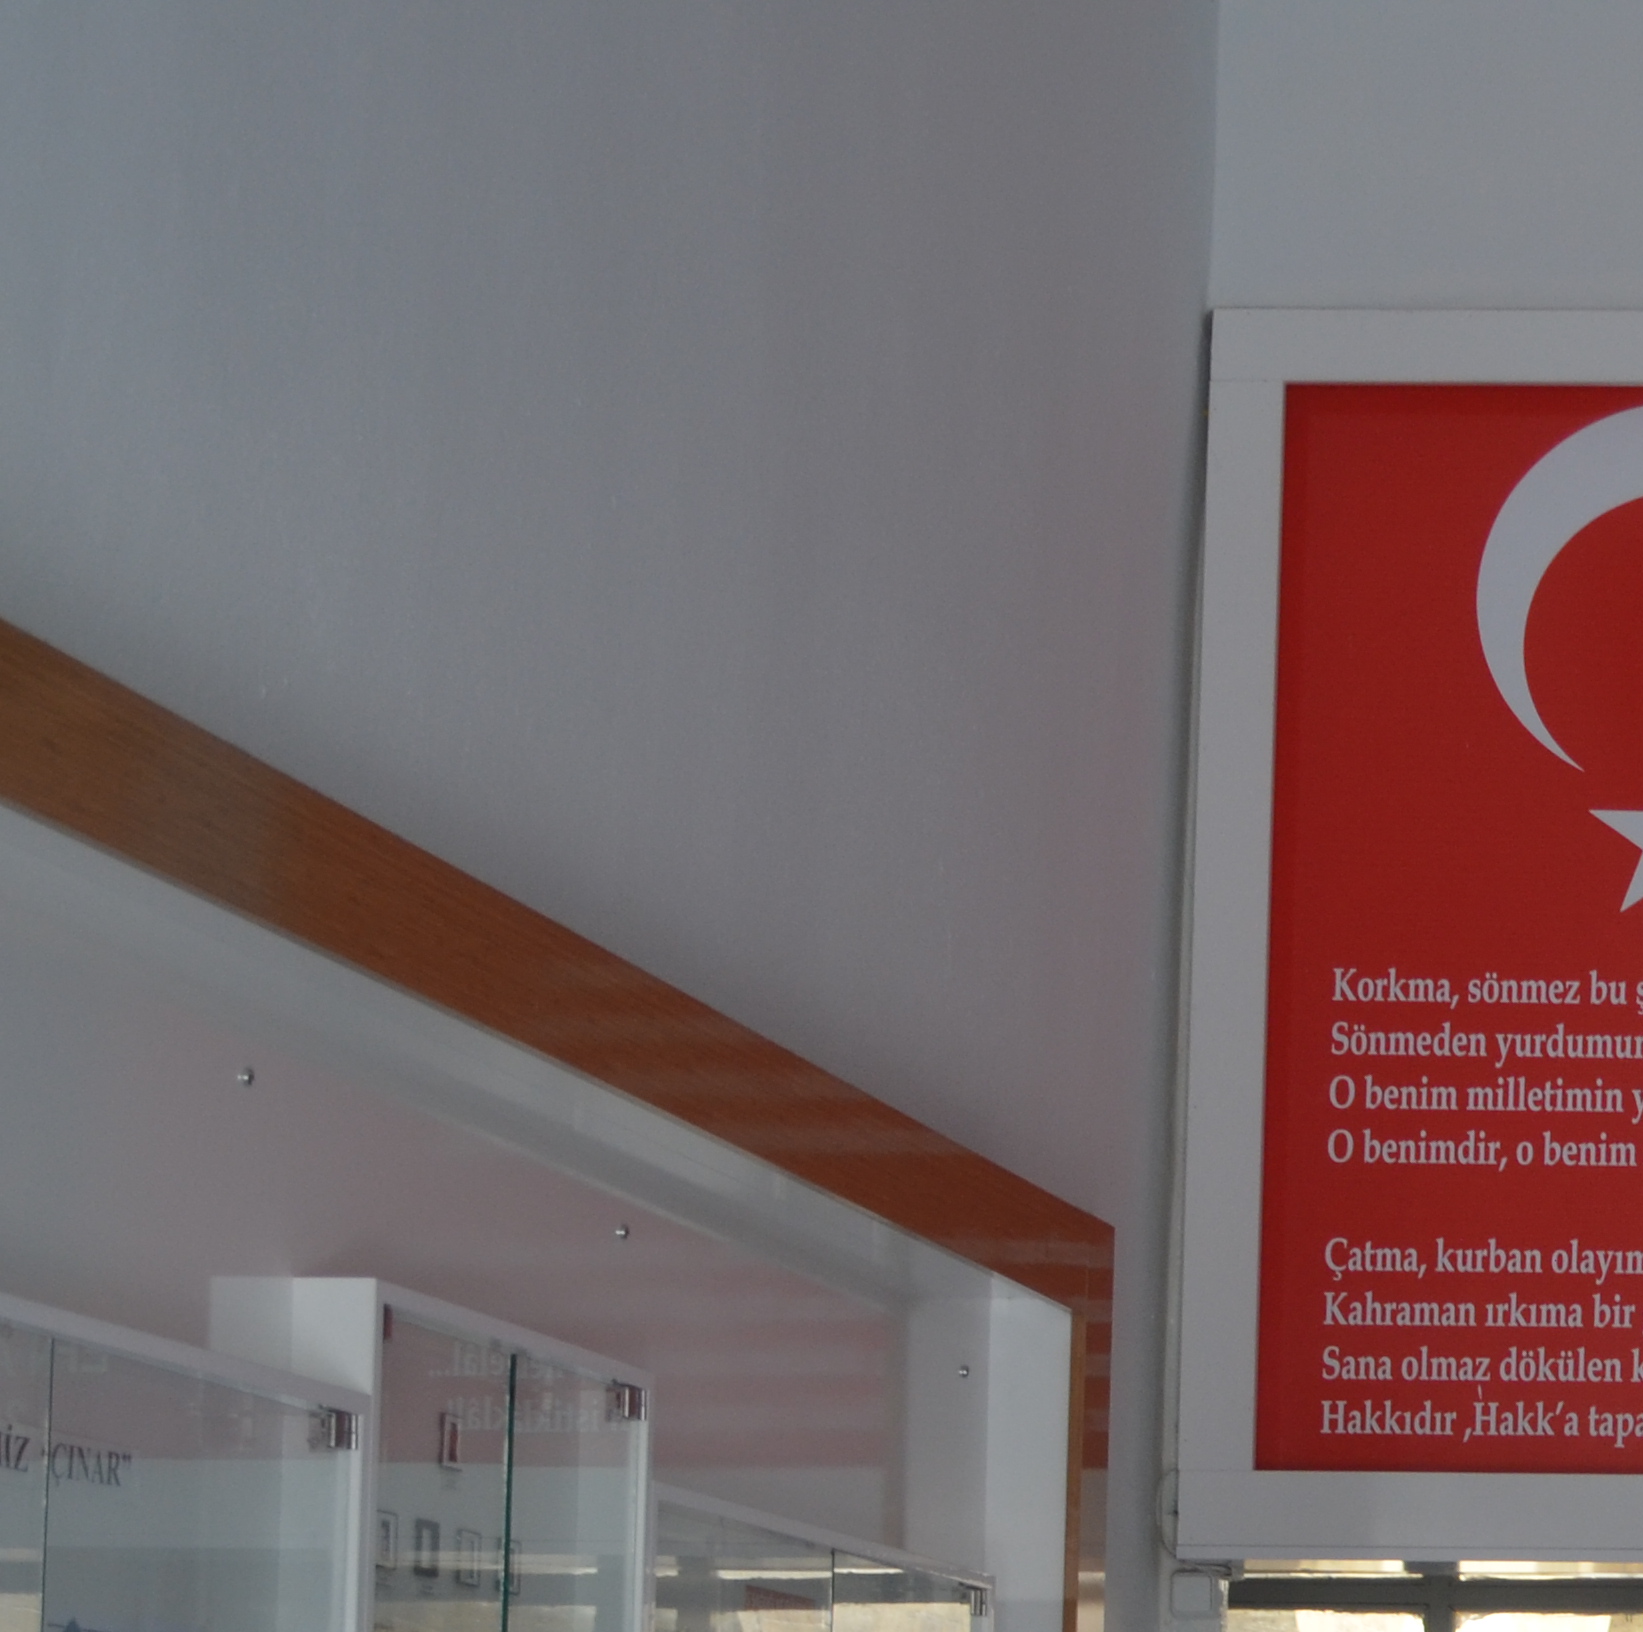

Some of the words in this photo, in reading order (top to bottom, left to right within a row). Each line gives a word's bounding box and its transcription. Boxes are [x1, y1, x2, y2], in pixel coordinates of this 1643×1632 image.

[1333, 967, 1461, 1011] Korkma,
[1468, 972, 1582, 1007] sönmez
[1590, 969, 1629, 1007] bu
[1332, 1021, 1489, 1059] Sönmeden
[1330, 1075, 1357, 1111] O
[1365, 1074, 1460, 1112] benim
[1467, 1076, 1625, 1115] milletimin
[1328, 1128, 1355, 1164] O
[1364, 1129, 1509, 1174] benimdir,
[1516, 1141, 1535, 1167] o
[1543, 1130, 1638, 1169] benim
[1325, 1237, 1428, 1283] Çatma,
[1436, 1237, 1544, 1275] kurban
[1324, 1291, 1478, 1329] Kahraman
[1485, 1292, 1585, 1329] ırkıma
[1593, 1293, 1637, 1330] bir
[1323, 1345, 1394, 1382] Sana
[1402, 1346, 1492, 1384] olmaz
[1500, 1346, 1624, 1385] dökülen
[1321, 1399, 1458, 1437] Hakkıdır
